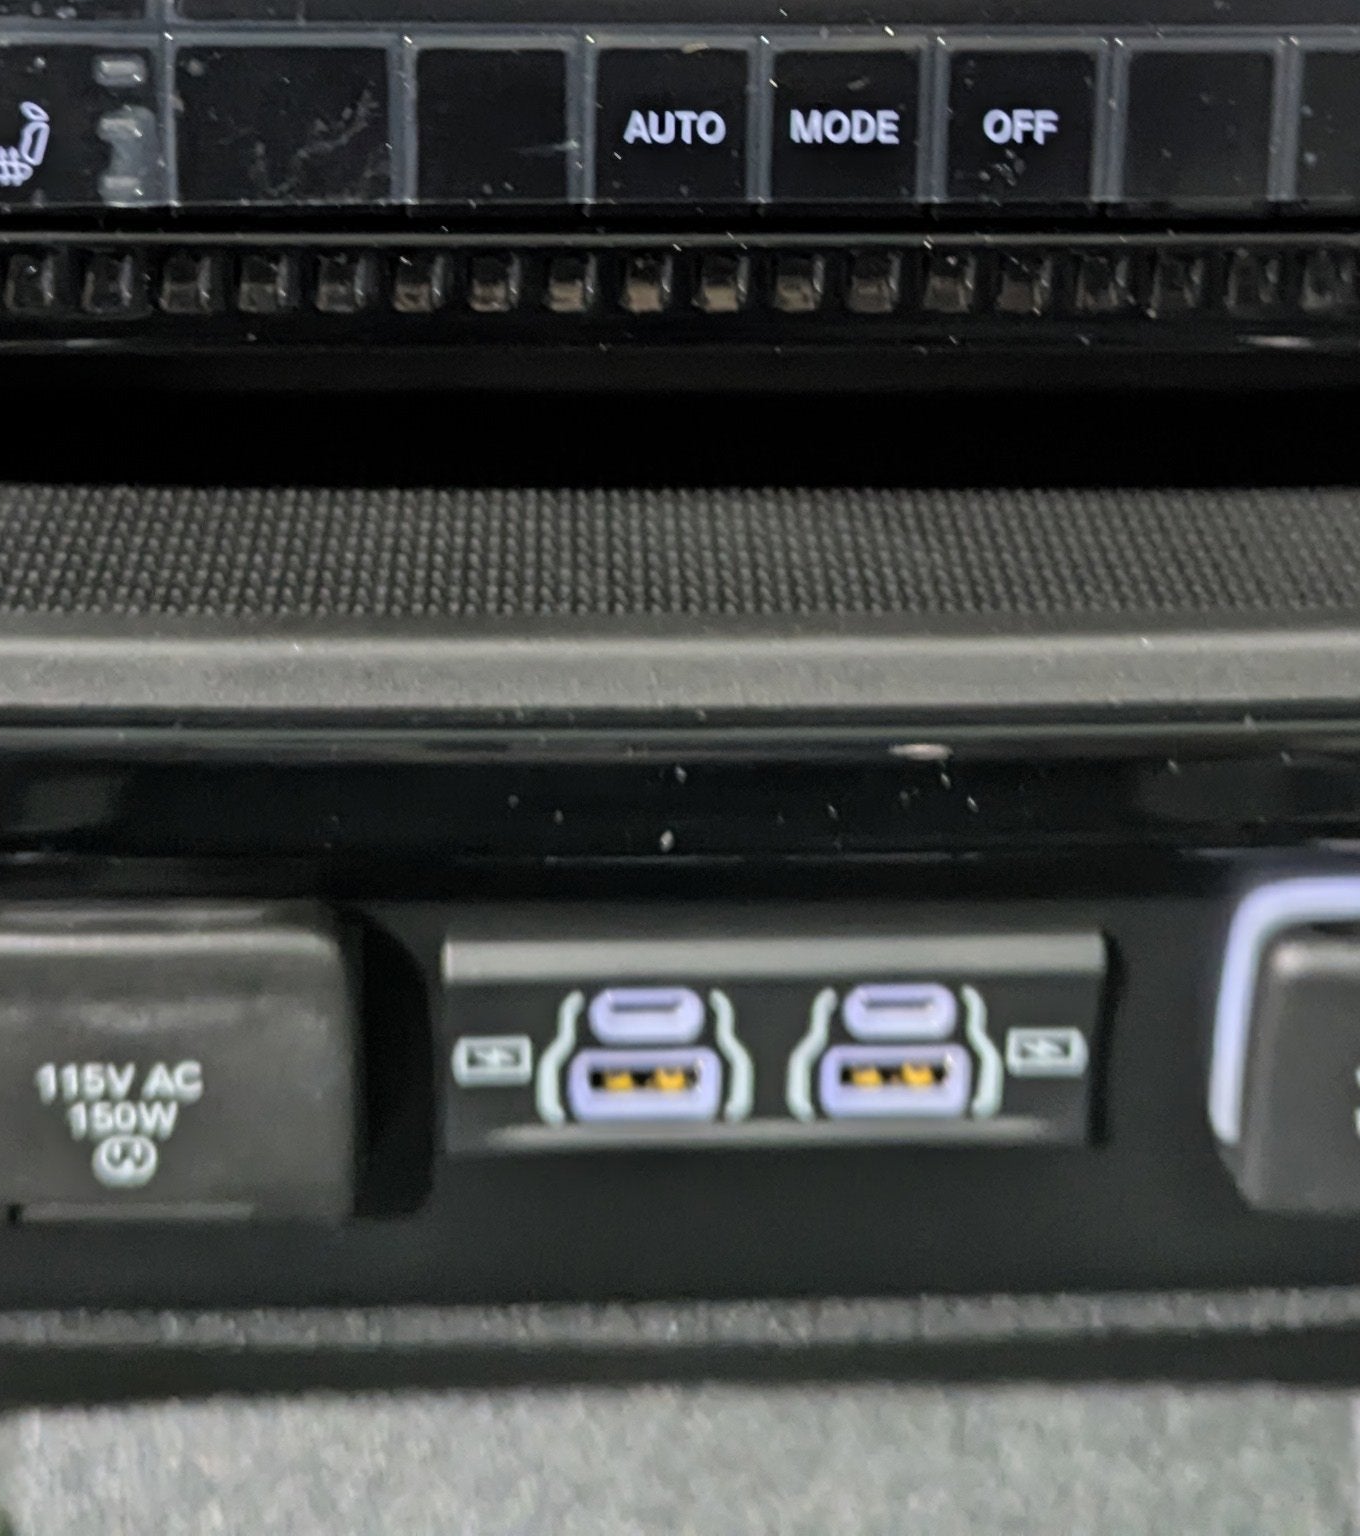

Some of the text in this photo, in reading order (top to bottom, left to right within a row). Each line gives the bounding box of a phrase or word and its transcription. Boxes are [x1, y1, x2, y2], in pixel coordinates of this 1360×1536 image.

[622, 109, 728, 146] AUTO
[788, 108, 901, 146] MODE
[981, 108, 1059, 146] OFF
[36, 1059, 204, 1104] 115V AC
[67, 1100, 178, 1141] 150W
